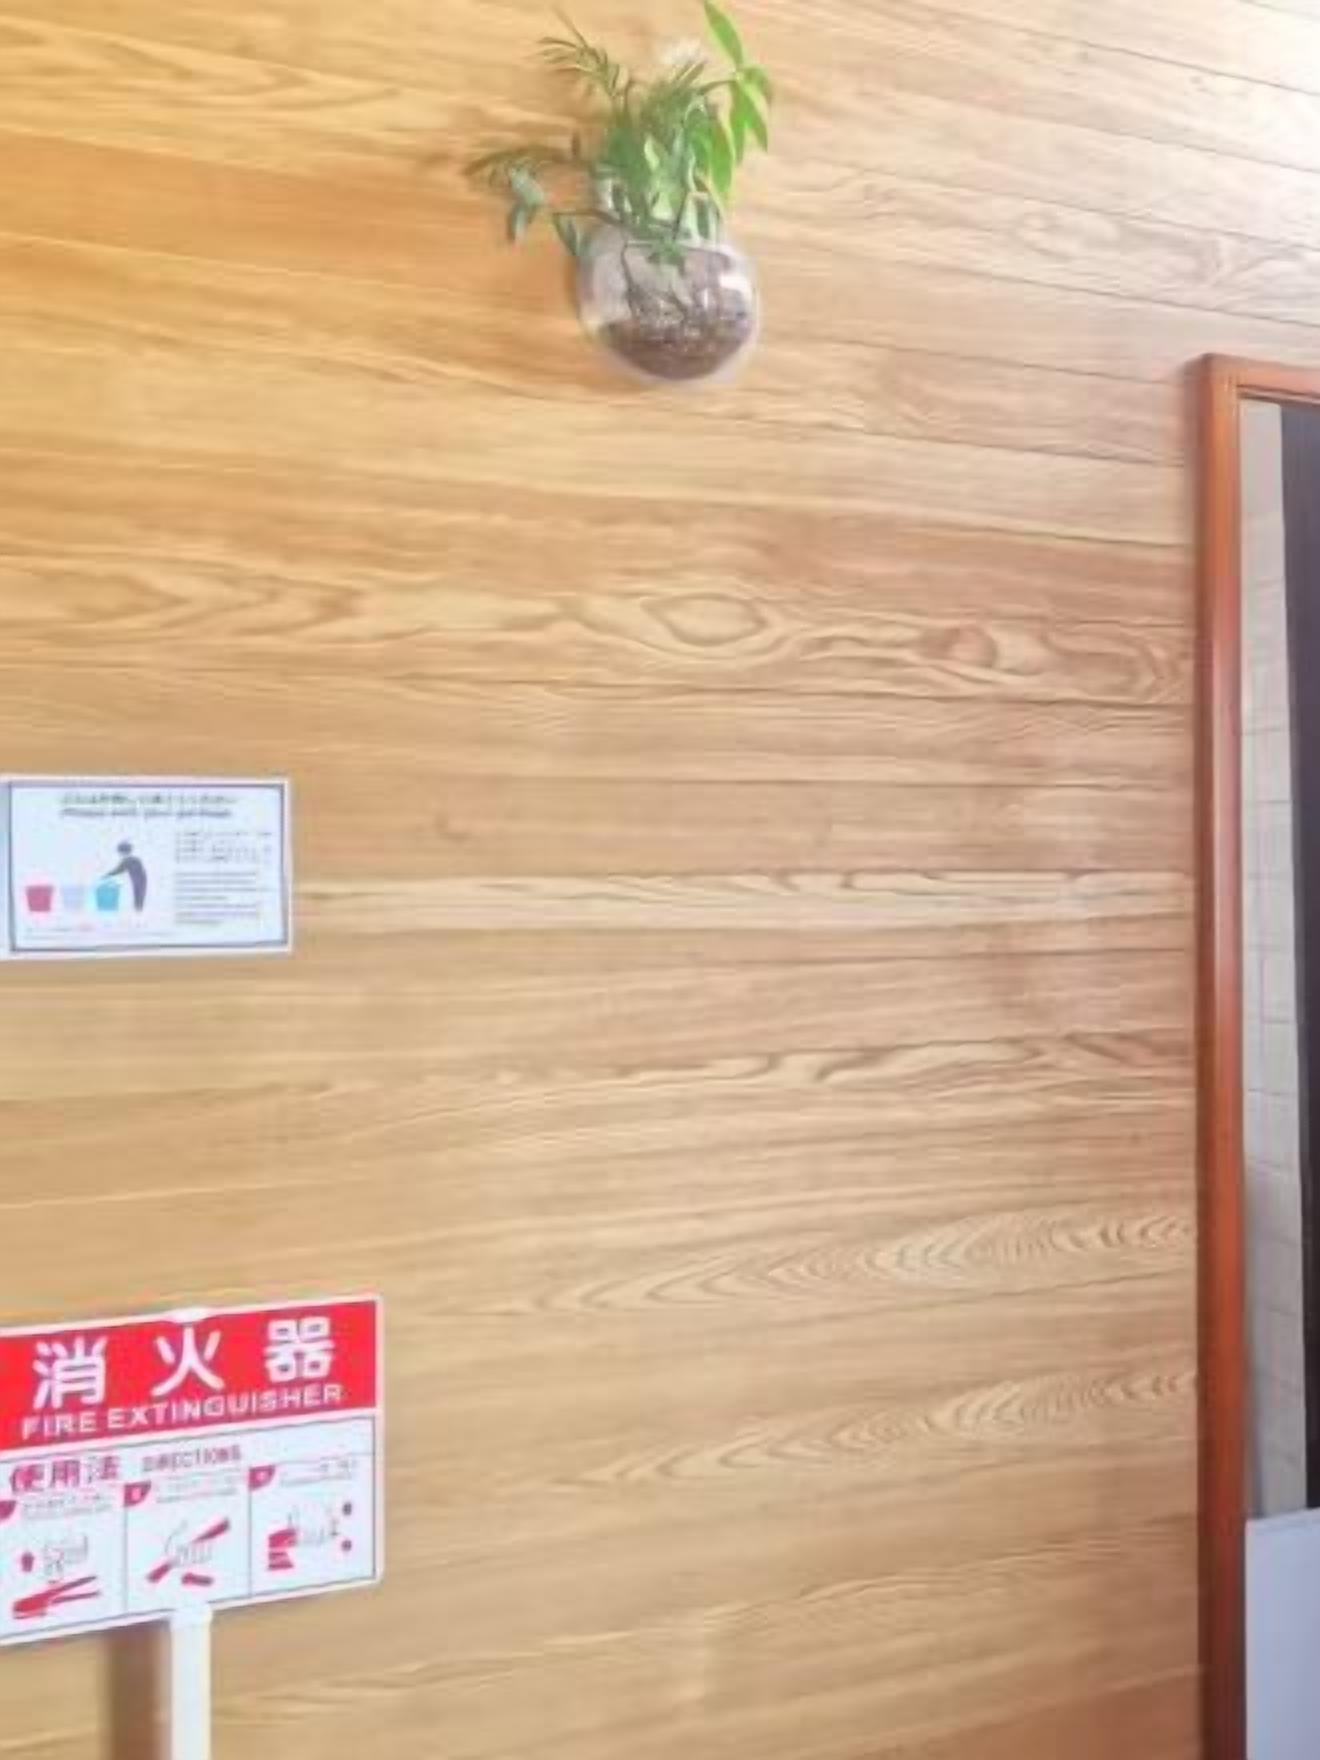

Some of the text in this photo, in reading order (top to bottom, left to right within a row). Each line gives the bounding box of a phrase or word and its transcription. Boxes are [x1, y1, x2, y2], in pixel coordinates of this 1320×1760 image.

[32, 1316, 335, 1410] 消火器
[22, 1383, 344, 1440] FIRE EXTINGUISHER
